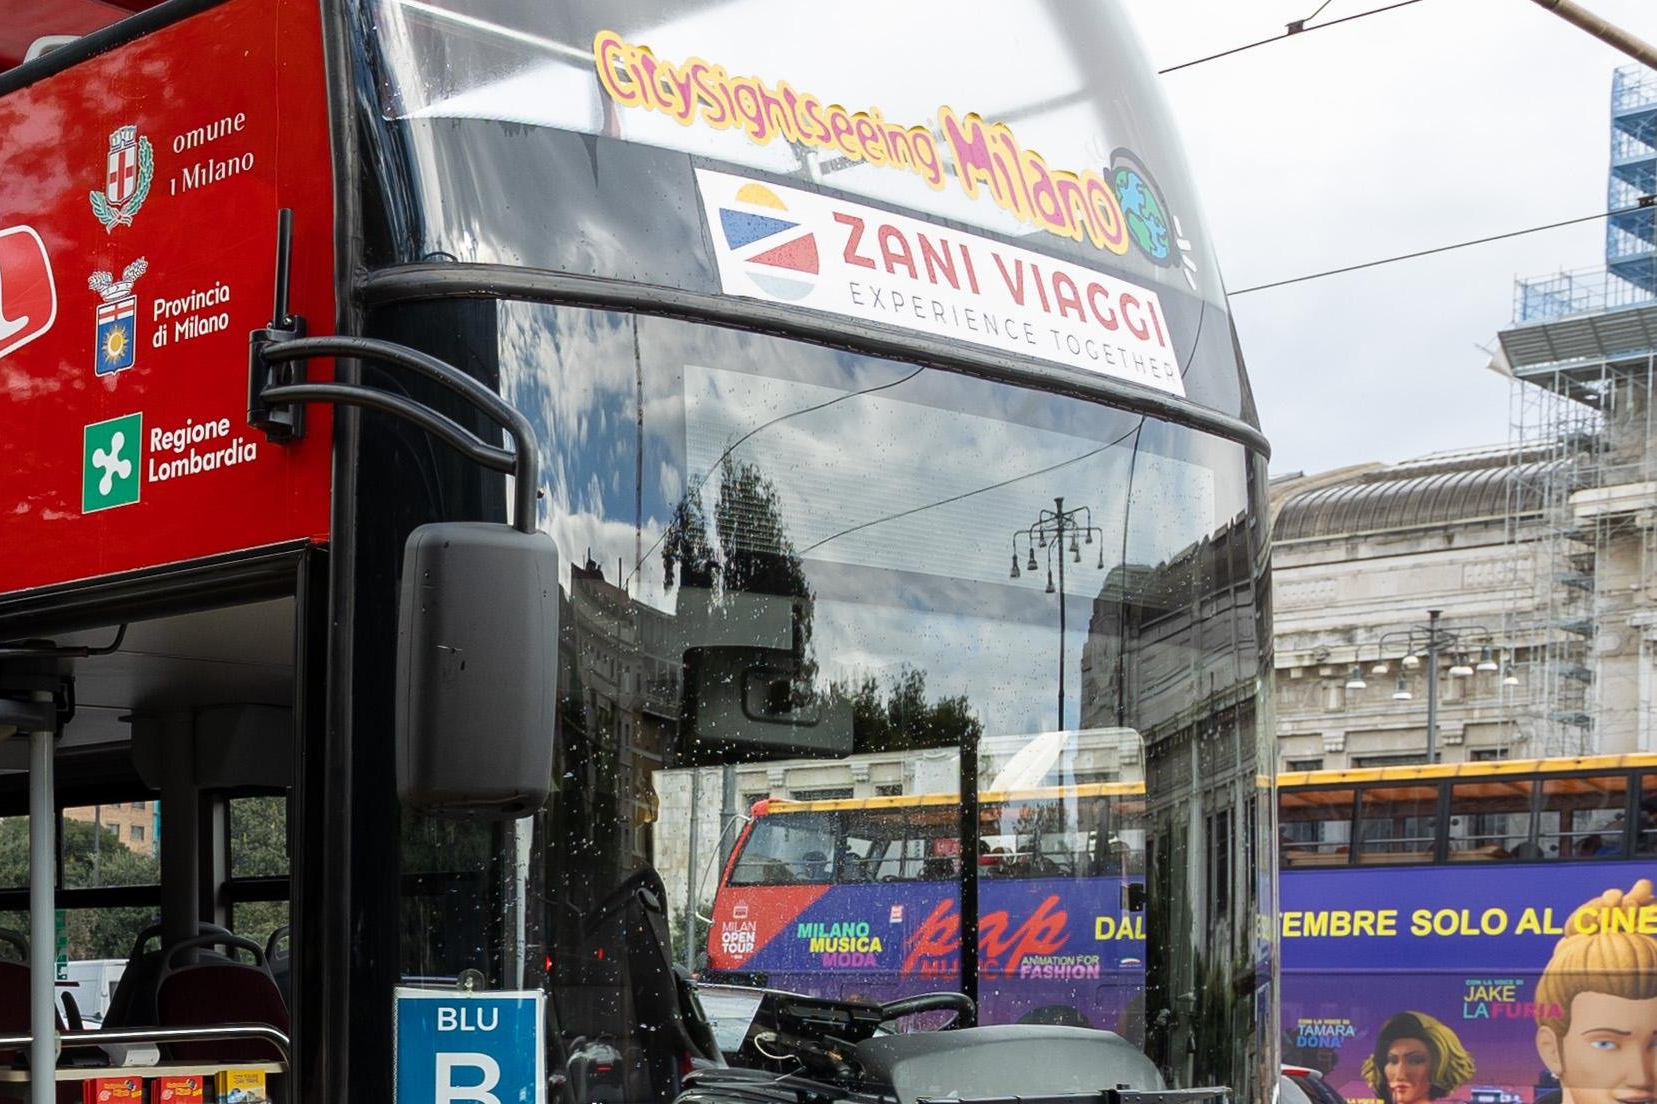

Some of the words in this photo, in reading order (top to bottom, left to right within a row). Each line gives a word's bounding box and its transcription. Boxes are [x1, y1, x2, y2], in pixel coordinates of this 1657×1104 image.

[182, 152, 254, 193] Milano
[939, 105, 1129, 254] Milano
[832, 211, 980, 294] ZANI
[991, 252, 1165, 347] VIAGGI
[153, 281, 230, 322] Provincia
[152, 324, 167, 348] di
[175, 312, 229, 343] Milano
[848, 281, 1038, 346] EXPERIENCE
[1050, 328, 1176, 382] TOGETHER
[150, 418, 230, 453] Regione
[148, 437, 257, 483] Lombardia
[722, 920, 756, 931] MILAN
[797, 922, 870, 938] MILANO
[1410, 908, 1508, 937] SOLO
[1515, 908, 1563, 935] AL
[721, 931, 755, 943] OPEN
[809, 937, 883, 953] MUSICA
[722, 942, 754, 954] TOUR
[822, 952, 877, 967] MODA
[1022, 955, 1075, 966] ANIMATION
[1077, 954, 1100, 965] FOR
[1020, 964, 1101, 980] FASHION
[1463, 985, 1516, 1002] JAKE
[437, 1006, 499, 1031] BLU
[1297, 1024, 1355, 1037] TAMARA
